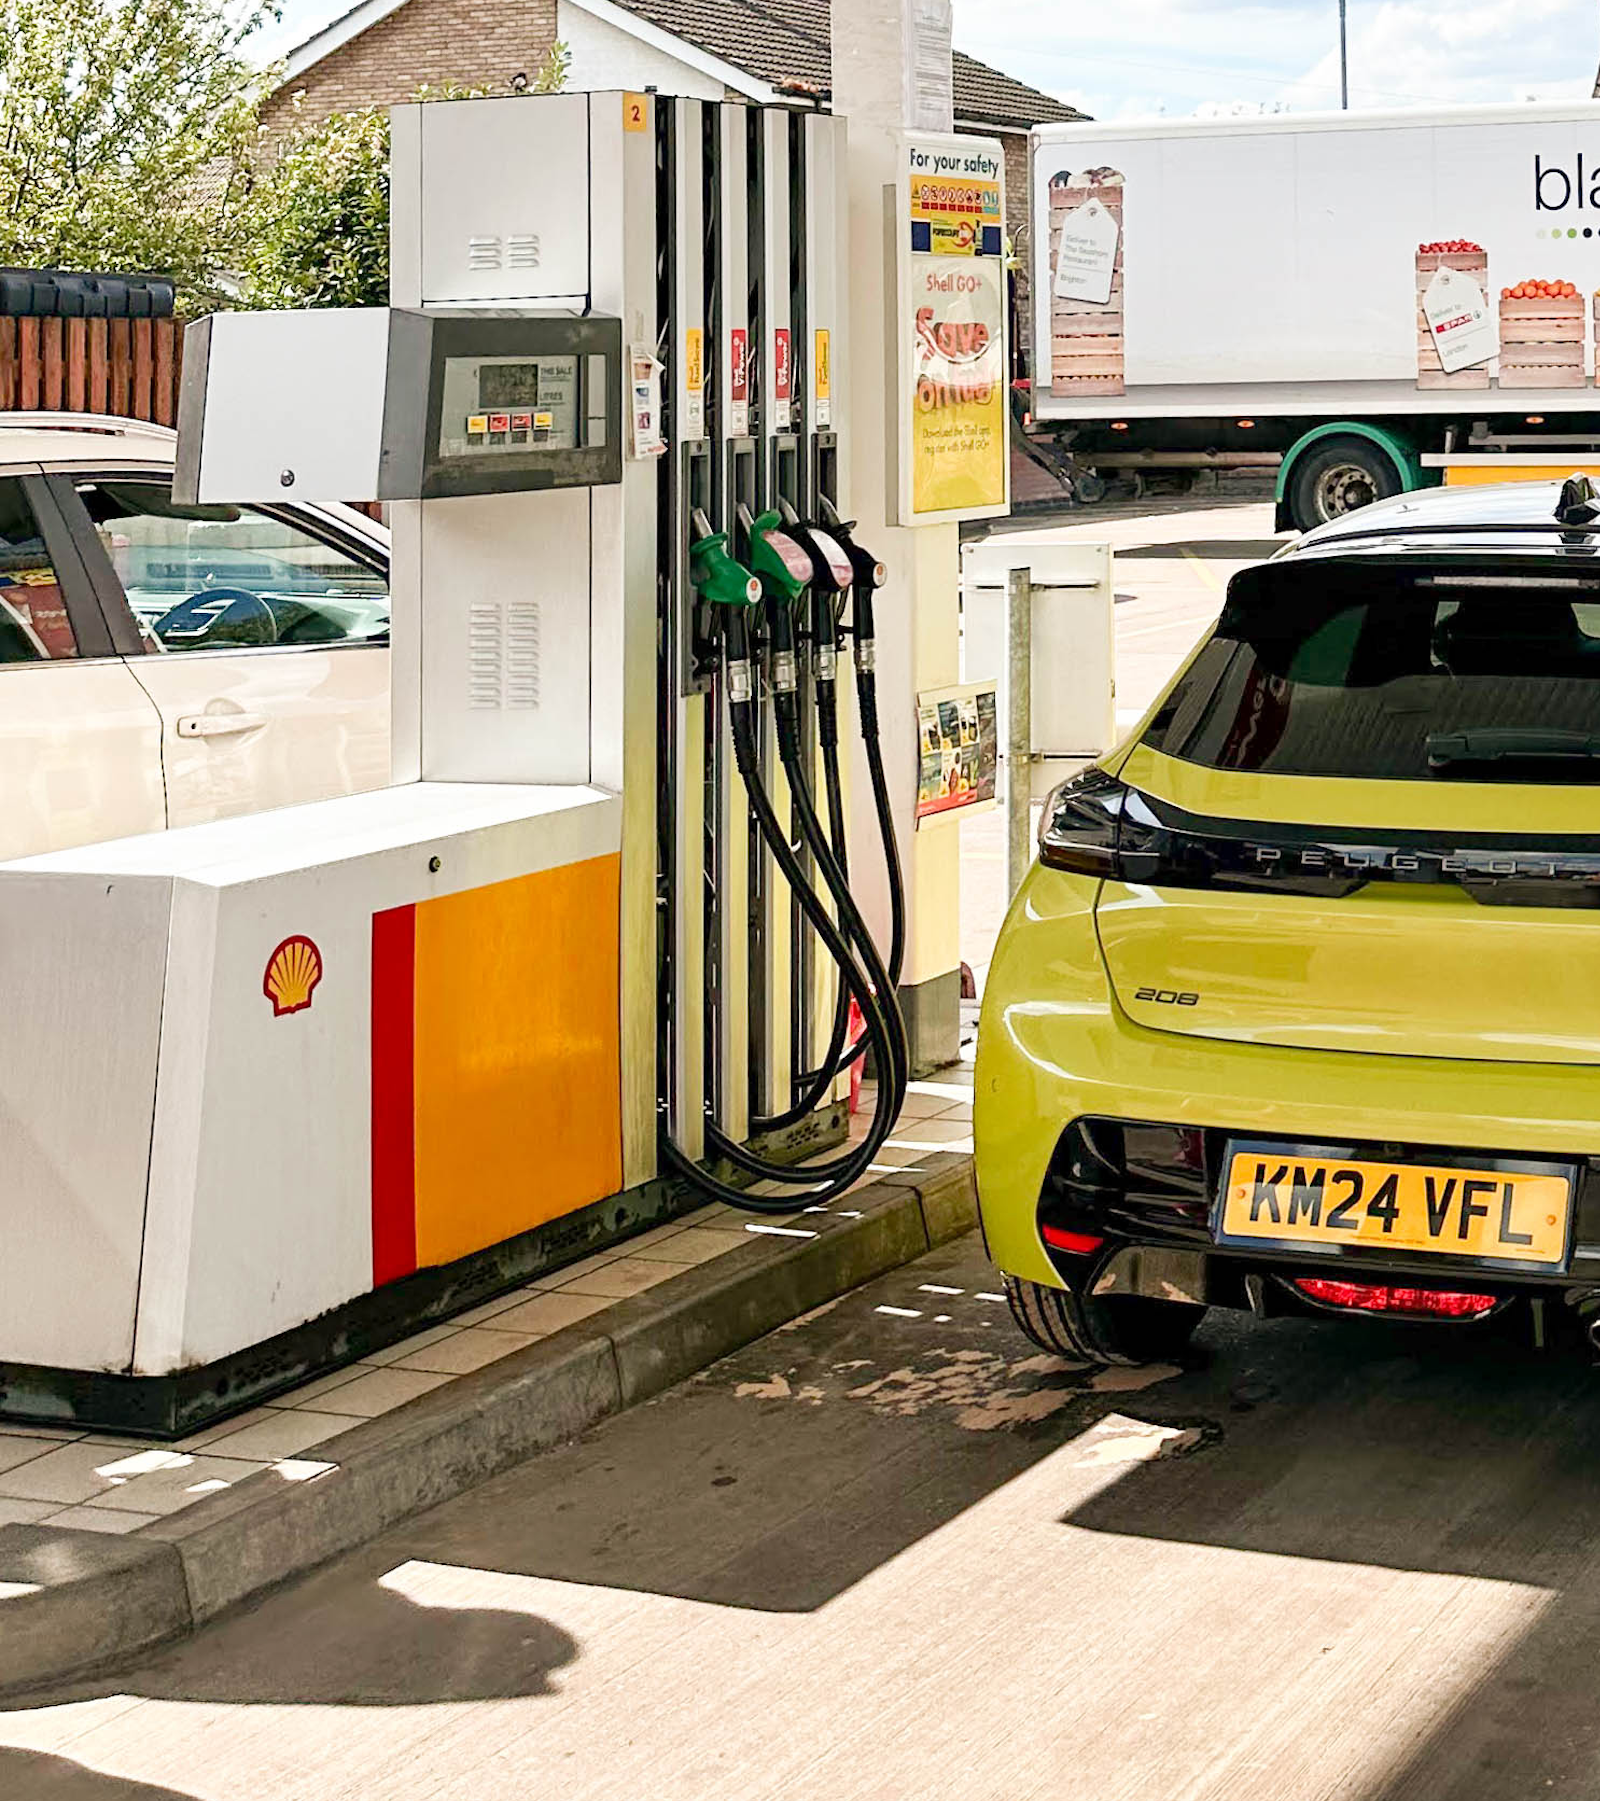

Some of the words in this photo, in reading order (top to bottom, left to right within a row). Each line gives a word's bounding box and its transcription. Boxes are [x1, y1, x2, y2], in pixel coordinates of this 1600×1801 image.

[631, 105, 641, 122] 2
[910, 148, 930, 167] For
[933, 154, 961, 174] your
[964, 153, 999, 179] safety
[926, 273, 953, 293] Shell
[956, 274, 982, 294] GO+
[1256, 847, 1564, 876] PEUGEOT
[1134, 986, 1199, 1007] 208
[1248, 1163, 1400, 1233] KM24
[1423, 1178, 1534, 1246] VFL
